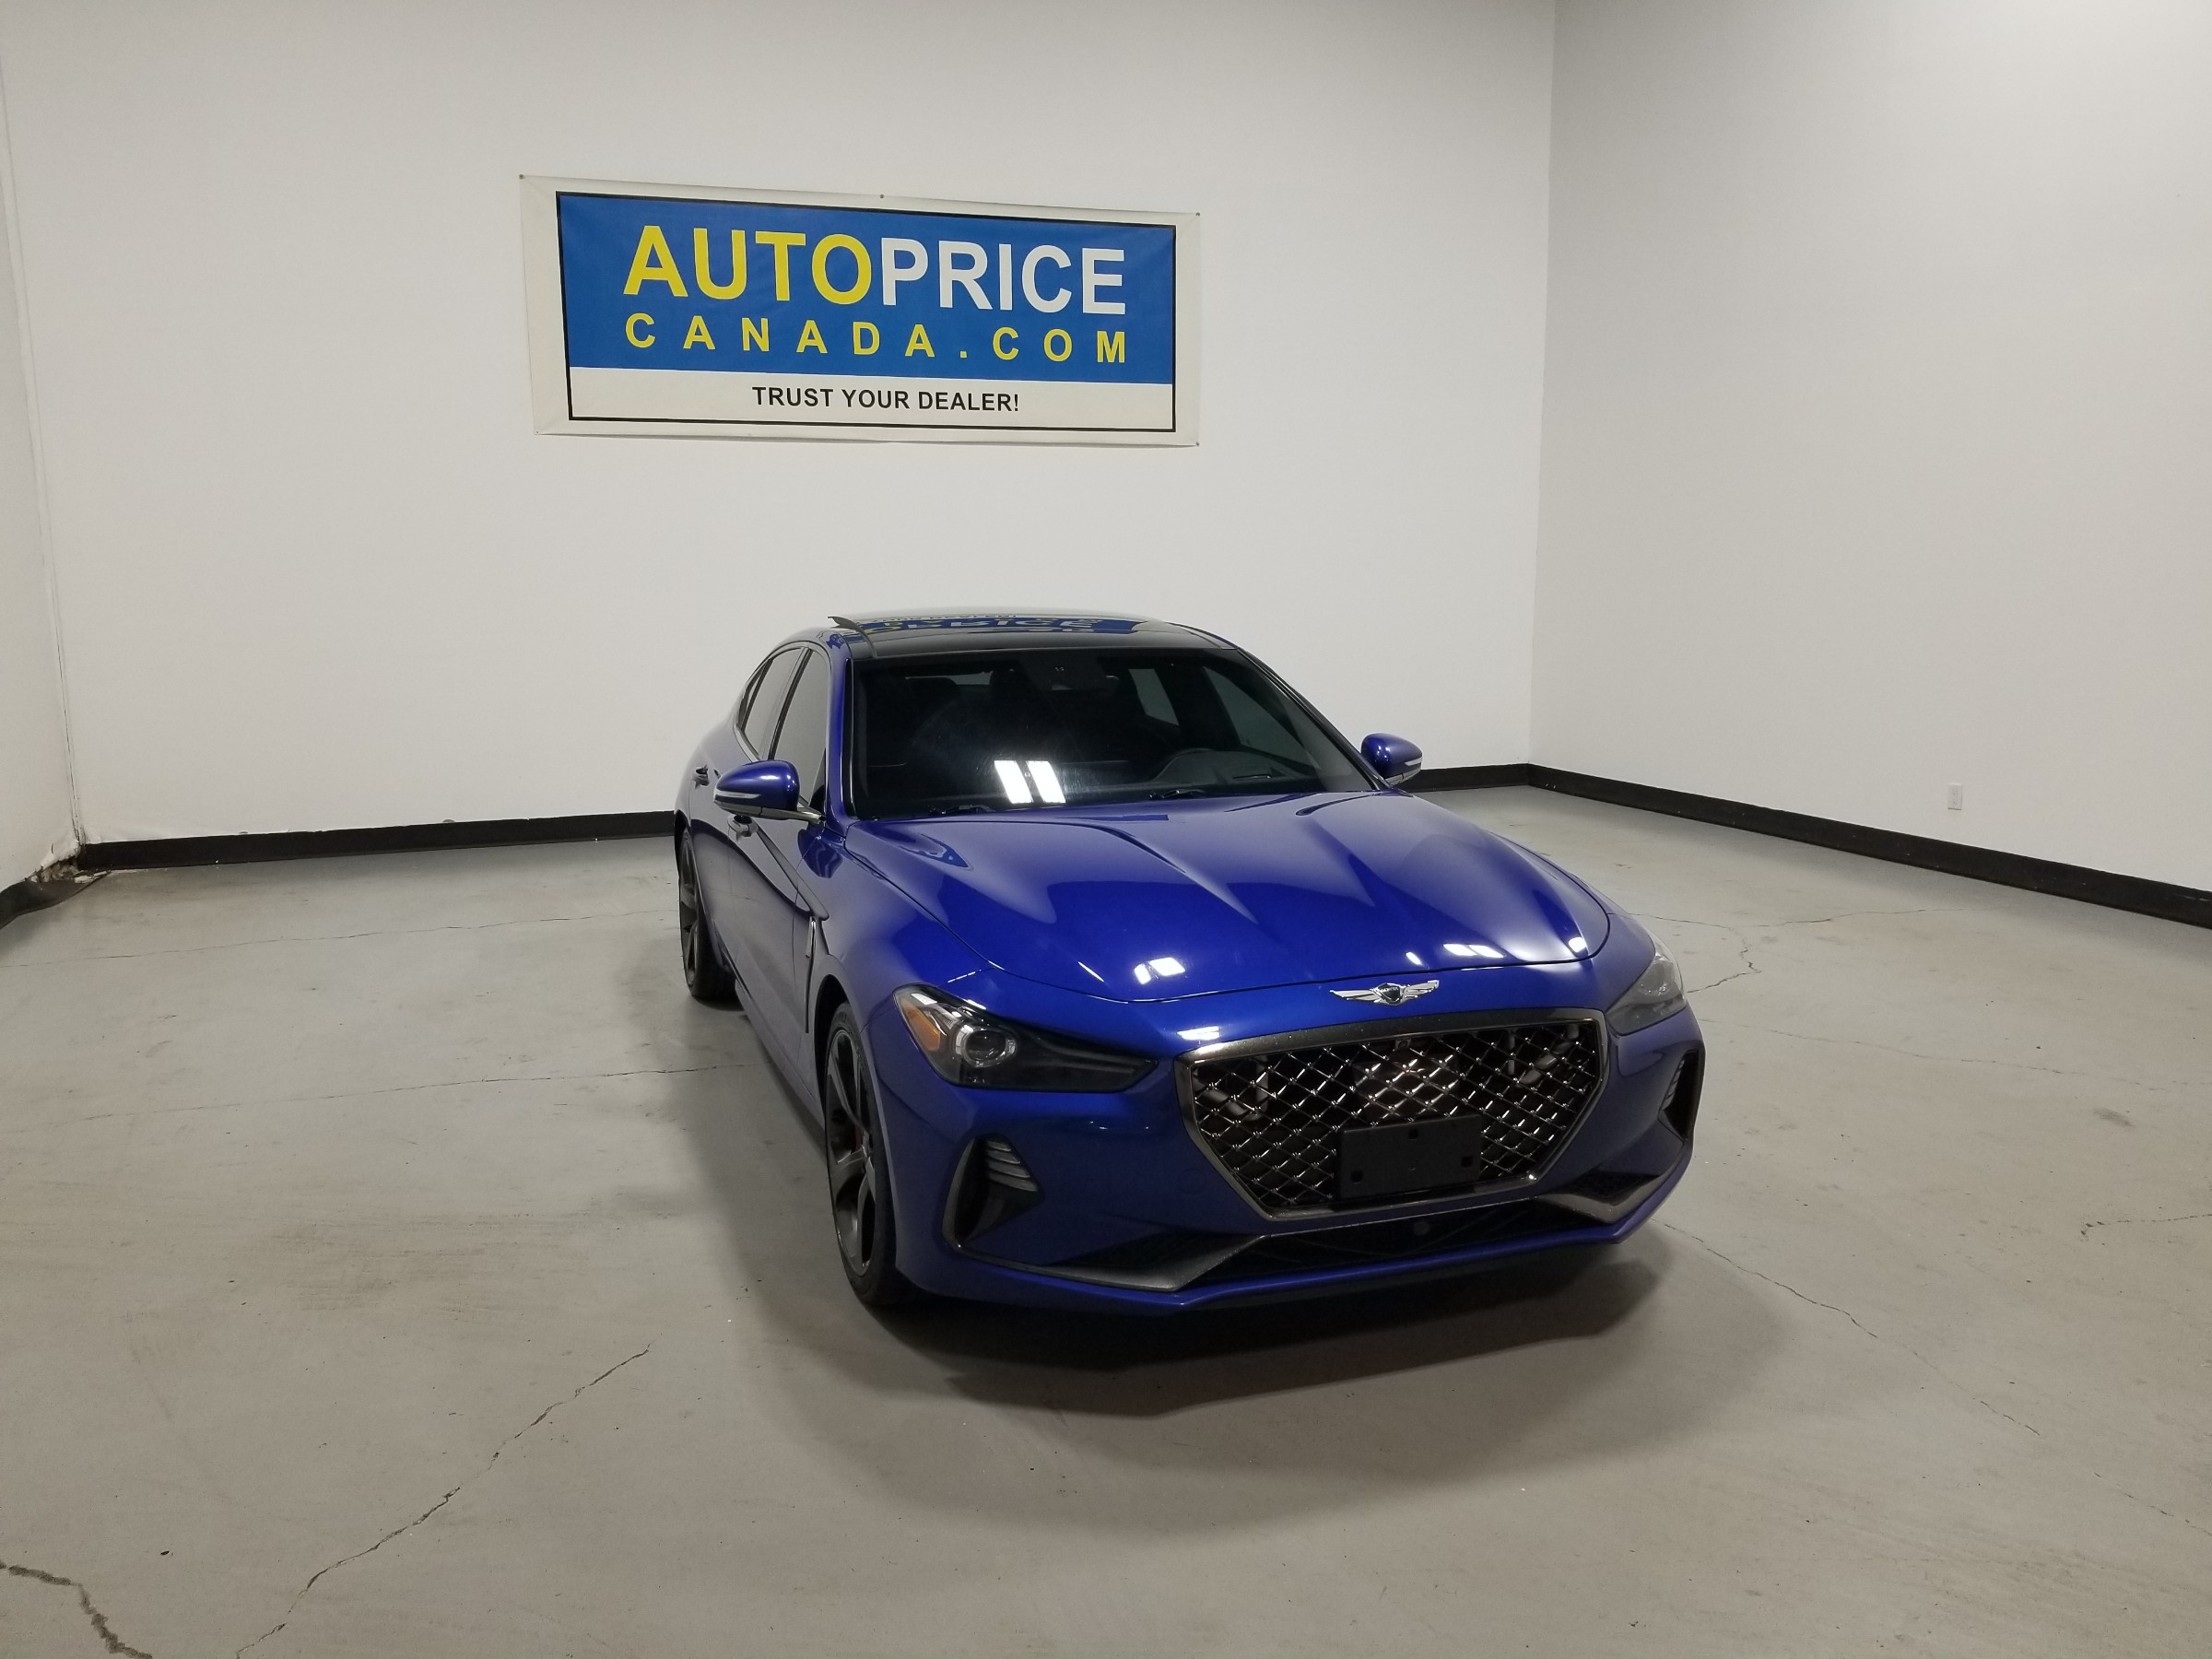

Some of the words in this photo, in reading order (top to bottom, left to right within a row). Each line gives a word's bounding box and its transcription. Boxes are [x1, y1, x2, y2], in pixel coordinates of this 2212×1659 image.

[624, 226, 1126, 315] AUTOPRICE
[626, 313, 1125, 362] CANADA.COM
[751, 386, 834, 407] TRUST
[841, 389, 911, 410] YOUR
[918, 392, 1018, 412] DEALER!
